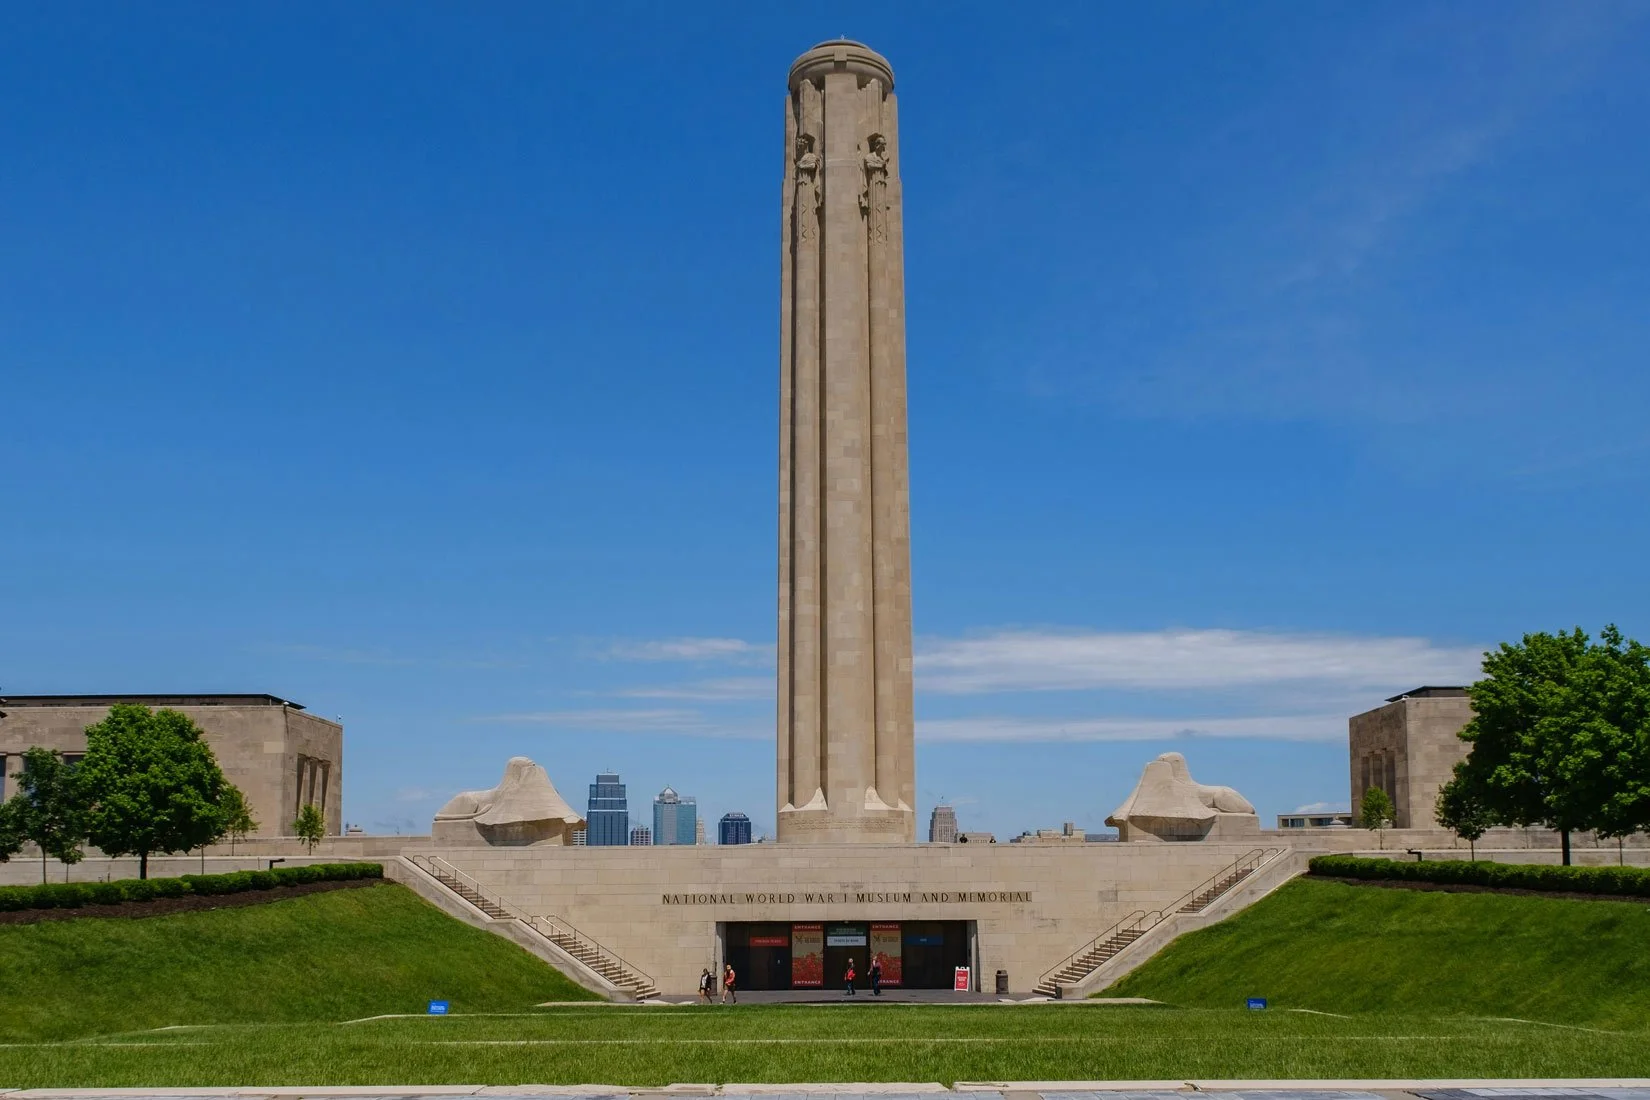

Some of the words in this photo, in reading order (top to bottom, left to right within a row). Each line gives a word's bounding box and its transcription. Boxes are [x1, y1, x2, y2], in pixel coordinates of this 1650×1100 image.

[662, 894, 736, 904] NATIONAL
[745, 894, 795, 904] WORLD
[804, 893, 834, 903] WAR
[856, 893, 911, 903] MUSEUM
[921, 892, 949, 902] AND
[958, 892, 1032, 902] MEMORIAL
